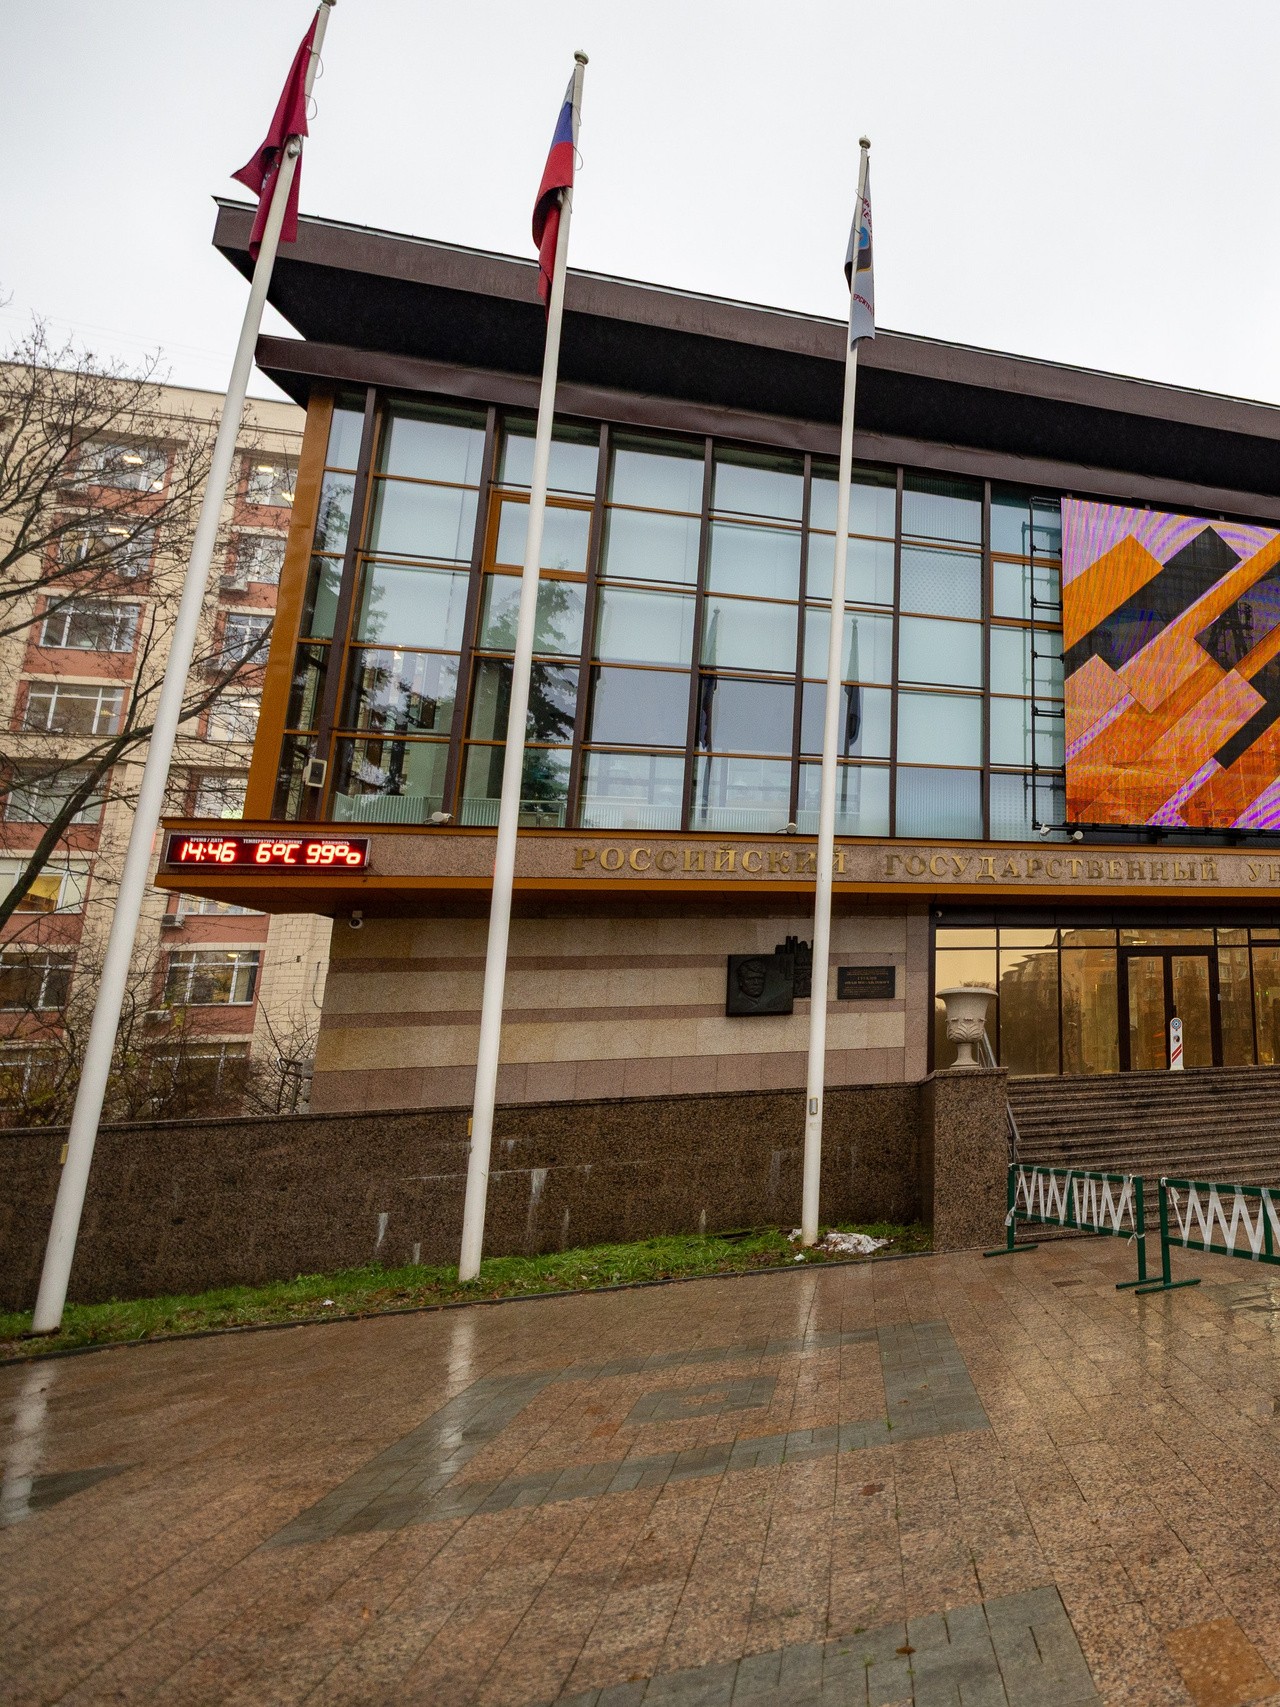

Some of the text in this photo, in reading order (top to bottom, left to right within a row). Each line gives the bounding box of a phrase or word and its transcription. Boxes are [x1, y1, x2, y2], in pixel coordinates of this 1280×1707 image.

[181, 842, 237, 863] 14:46
[572, 845, 848, 874] РОССИЙСКИЙ
[884, 853, 1219, 882] ГОСУДАРСТВЕННЫЙ
